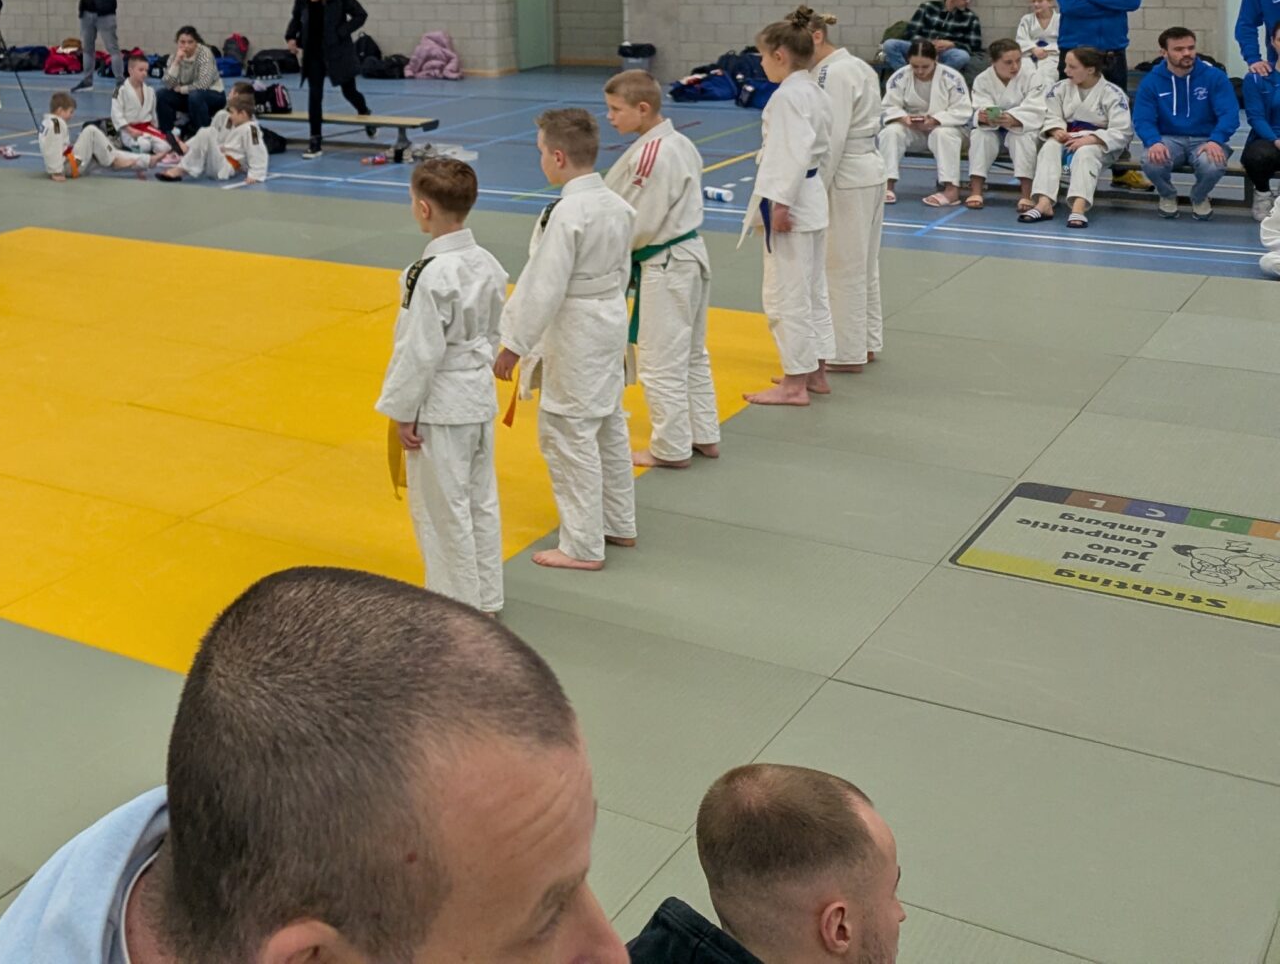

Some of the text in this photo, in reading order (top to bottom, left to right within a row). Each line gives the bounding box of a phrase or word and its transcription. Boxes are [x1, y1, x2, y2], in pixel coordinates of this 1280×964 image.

[1016, 518, 1159, 549] Competitie
[1059, 512, 1167, 539] Limburg
[1061, 551, 1147, 573] Jeugd
[1087, 542, 1154, 561] Judo
[1053, 568, 1228, 609] Stichting
